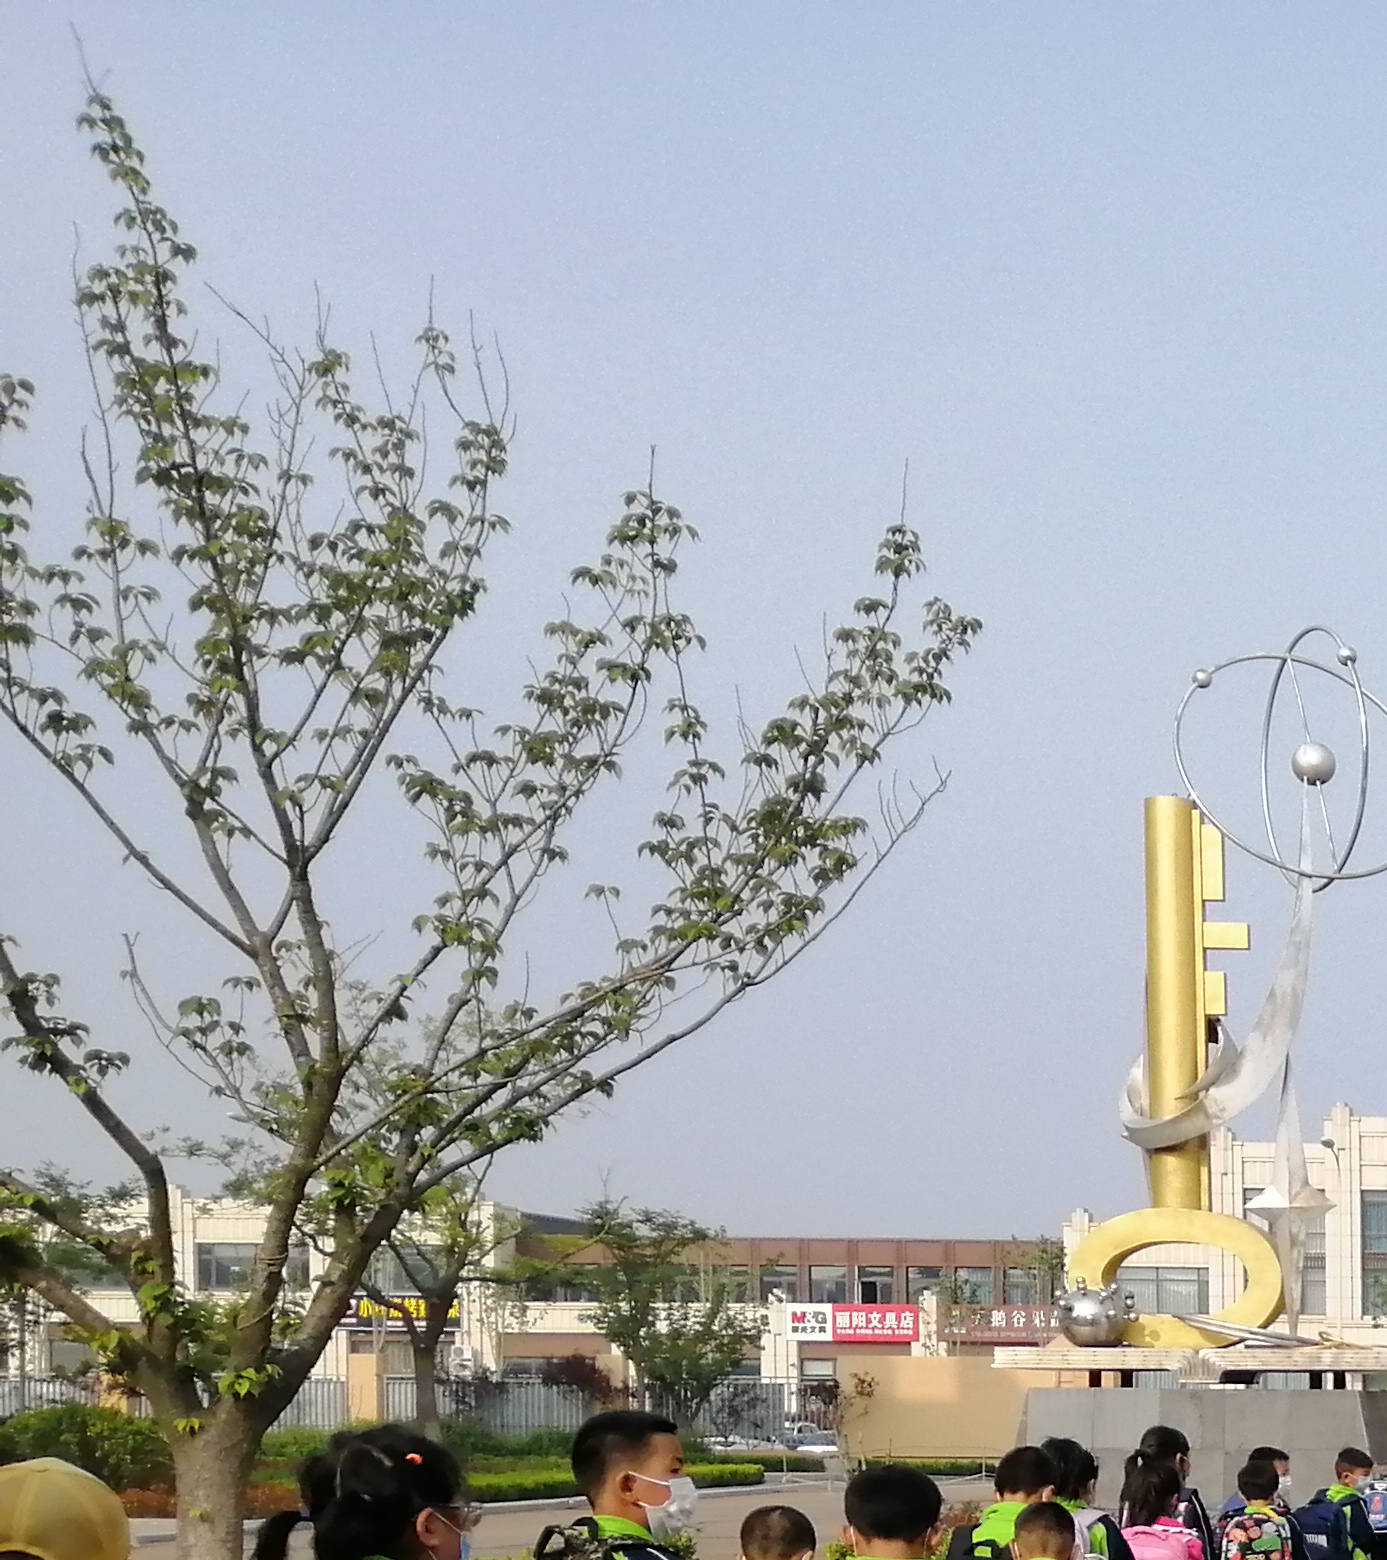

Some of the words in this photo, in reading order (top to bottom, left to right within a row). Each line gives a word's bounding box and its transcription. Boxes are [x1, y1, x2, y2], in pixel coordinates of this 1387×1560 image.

[791, 1311, 828, 1325] M&G
[835, 1311, 915, 1329] 丽阳文具店
